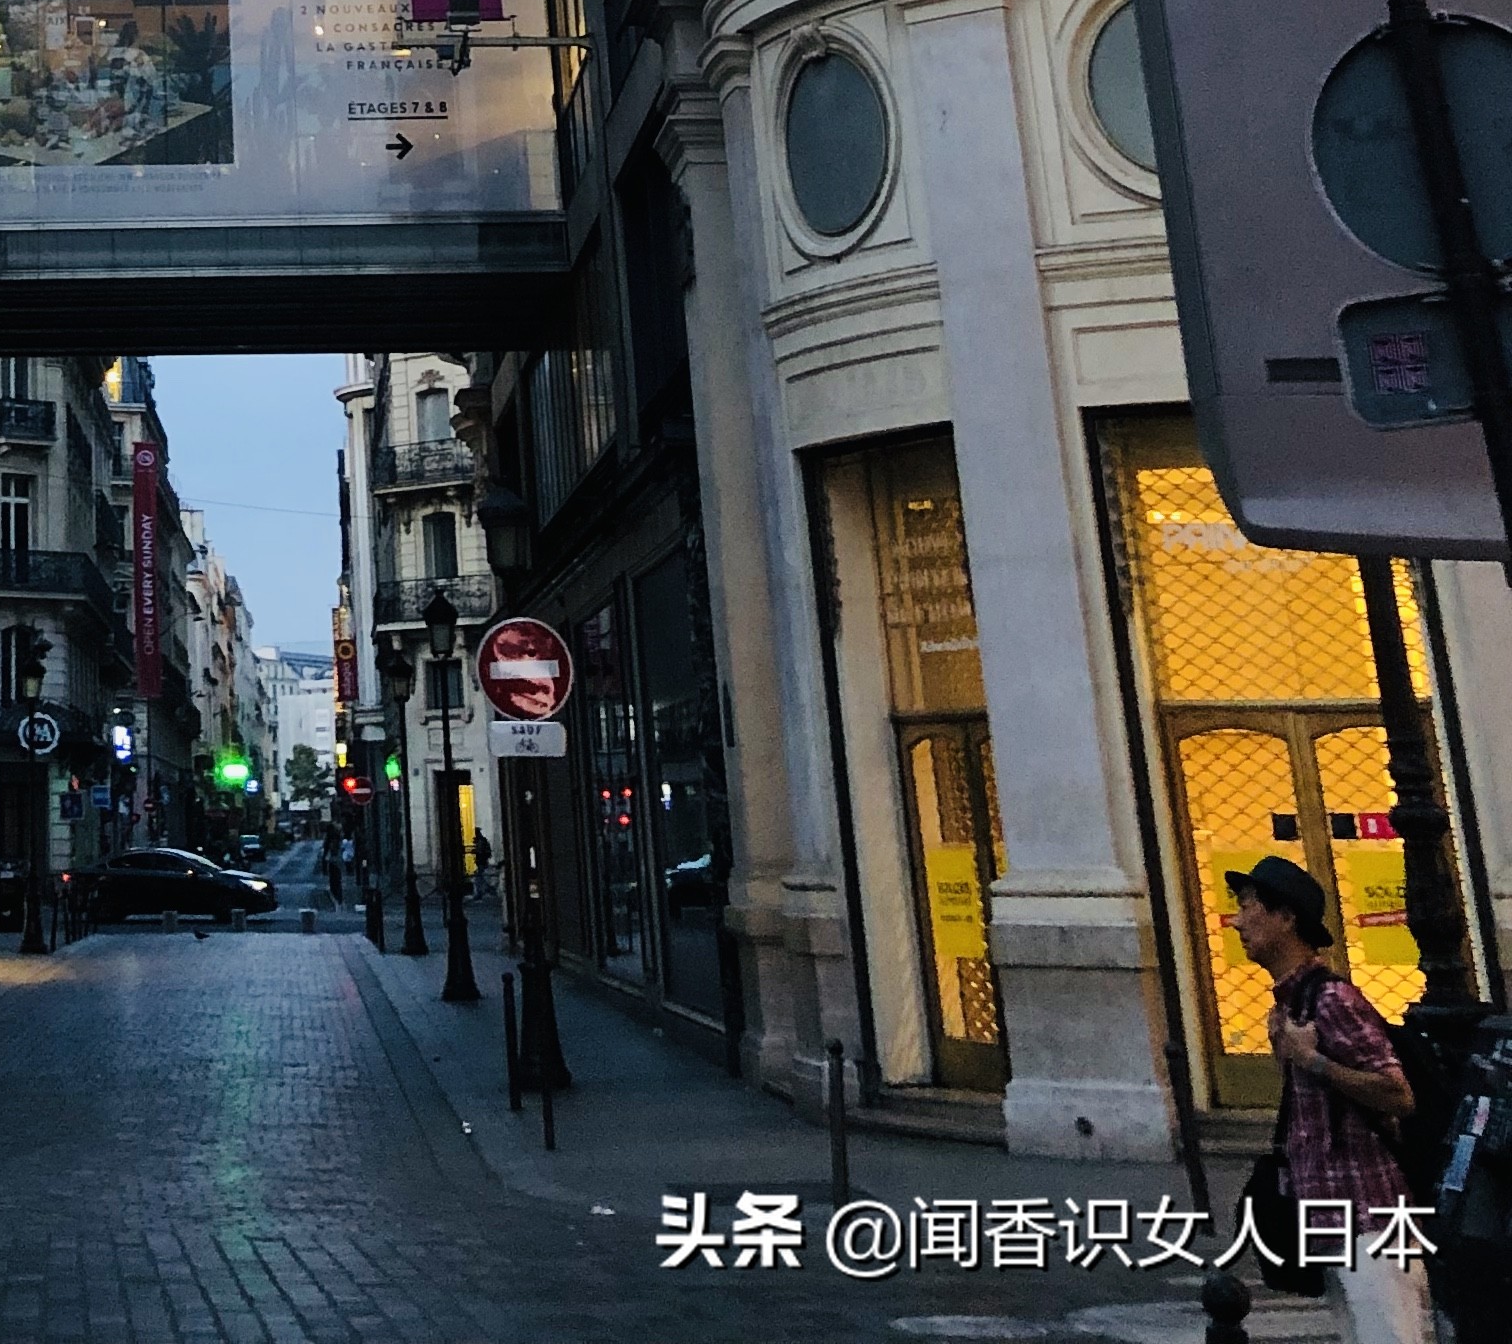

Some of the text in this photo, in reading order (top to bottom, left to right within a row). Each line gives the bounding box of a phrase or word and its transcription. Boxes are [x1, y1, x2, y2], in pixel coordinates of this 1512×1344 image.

[301, 3, 410, 15] 2 NOUVEAUX
[316, 42, 336, 53] LA
[411, 101, 419, 113] 7
[424, 101, 434, 113] &
[439, 101, 448, 113] 8
[141, 513, 155, 655] OPEN EVERY SUNDAY
